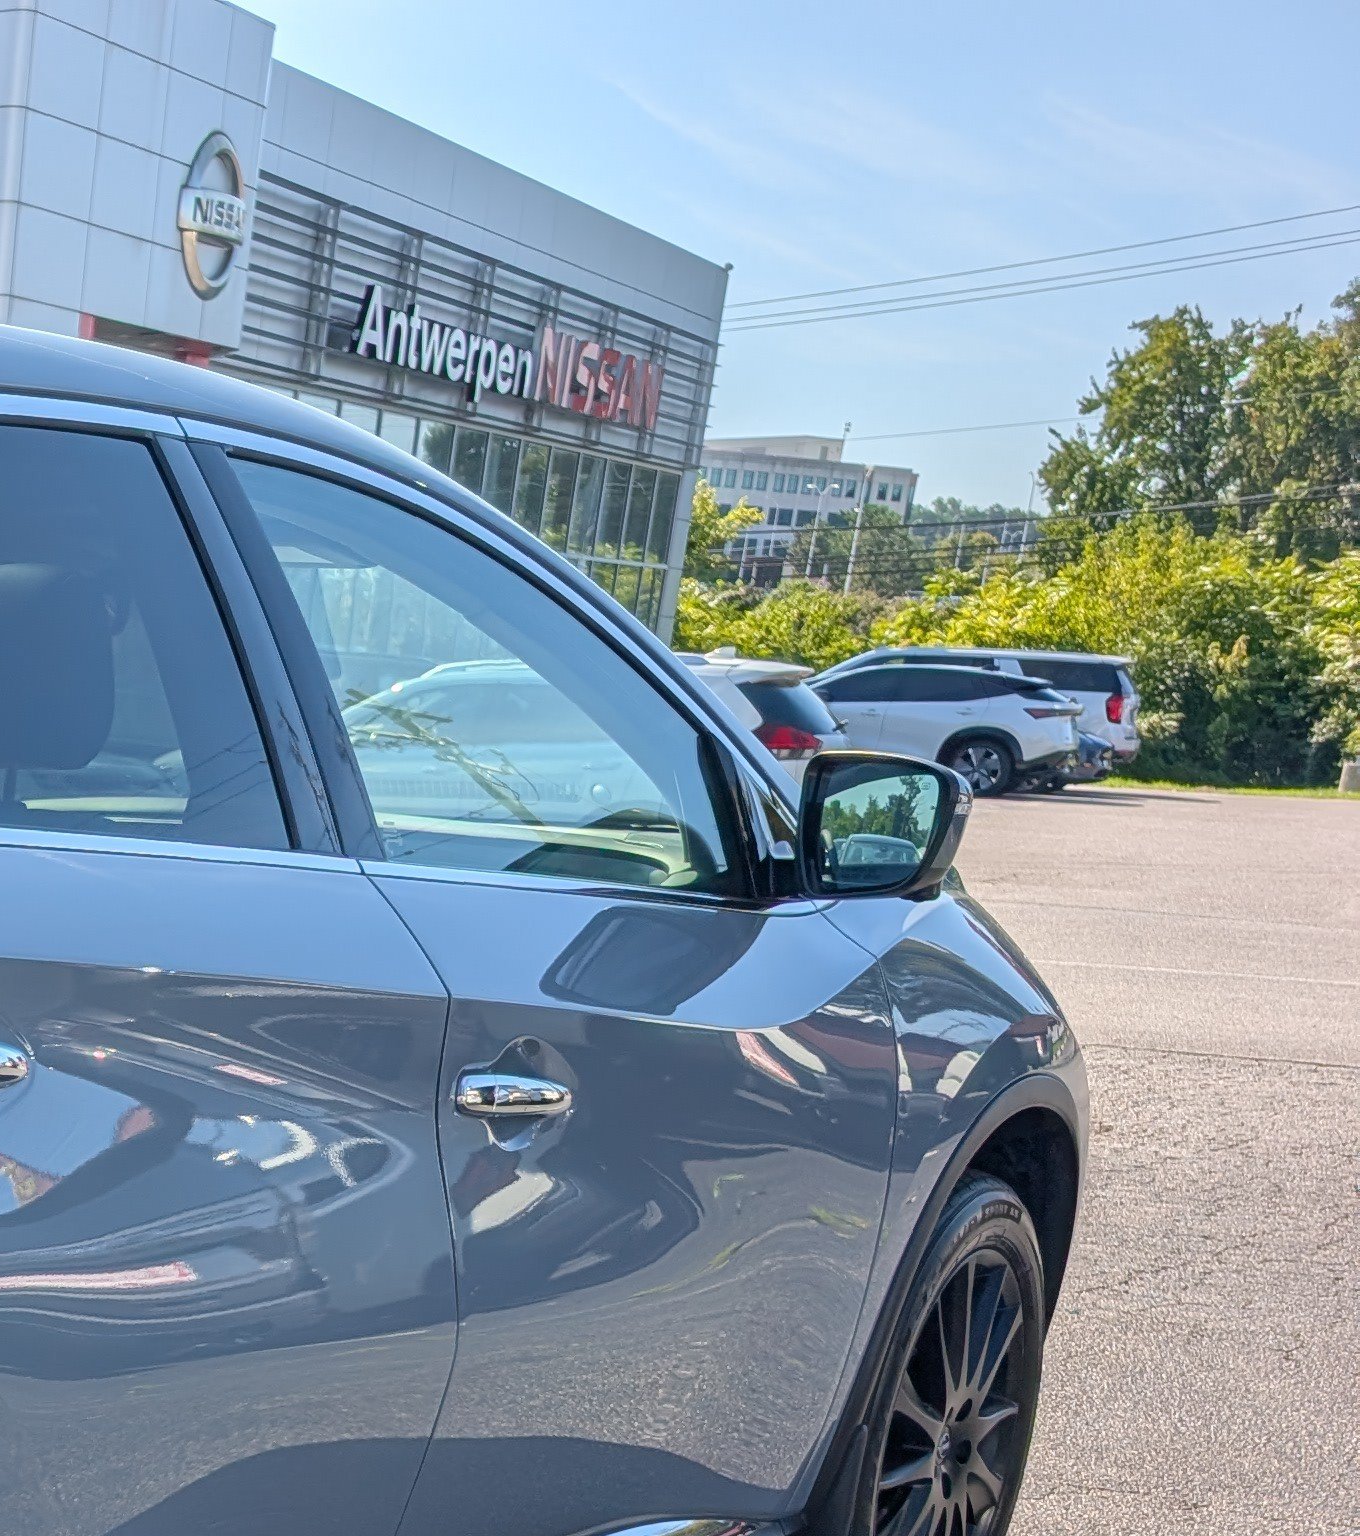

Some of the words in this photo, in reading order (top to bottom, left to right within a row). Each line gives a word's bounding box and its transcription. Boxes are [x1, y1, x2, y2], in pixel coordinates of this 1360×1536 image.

[191, 195, 243, 229] NISSA
[357, 284, 533, 403] Antwerpen
[534, 324, 665, 430] NISSAN
